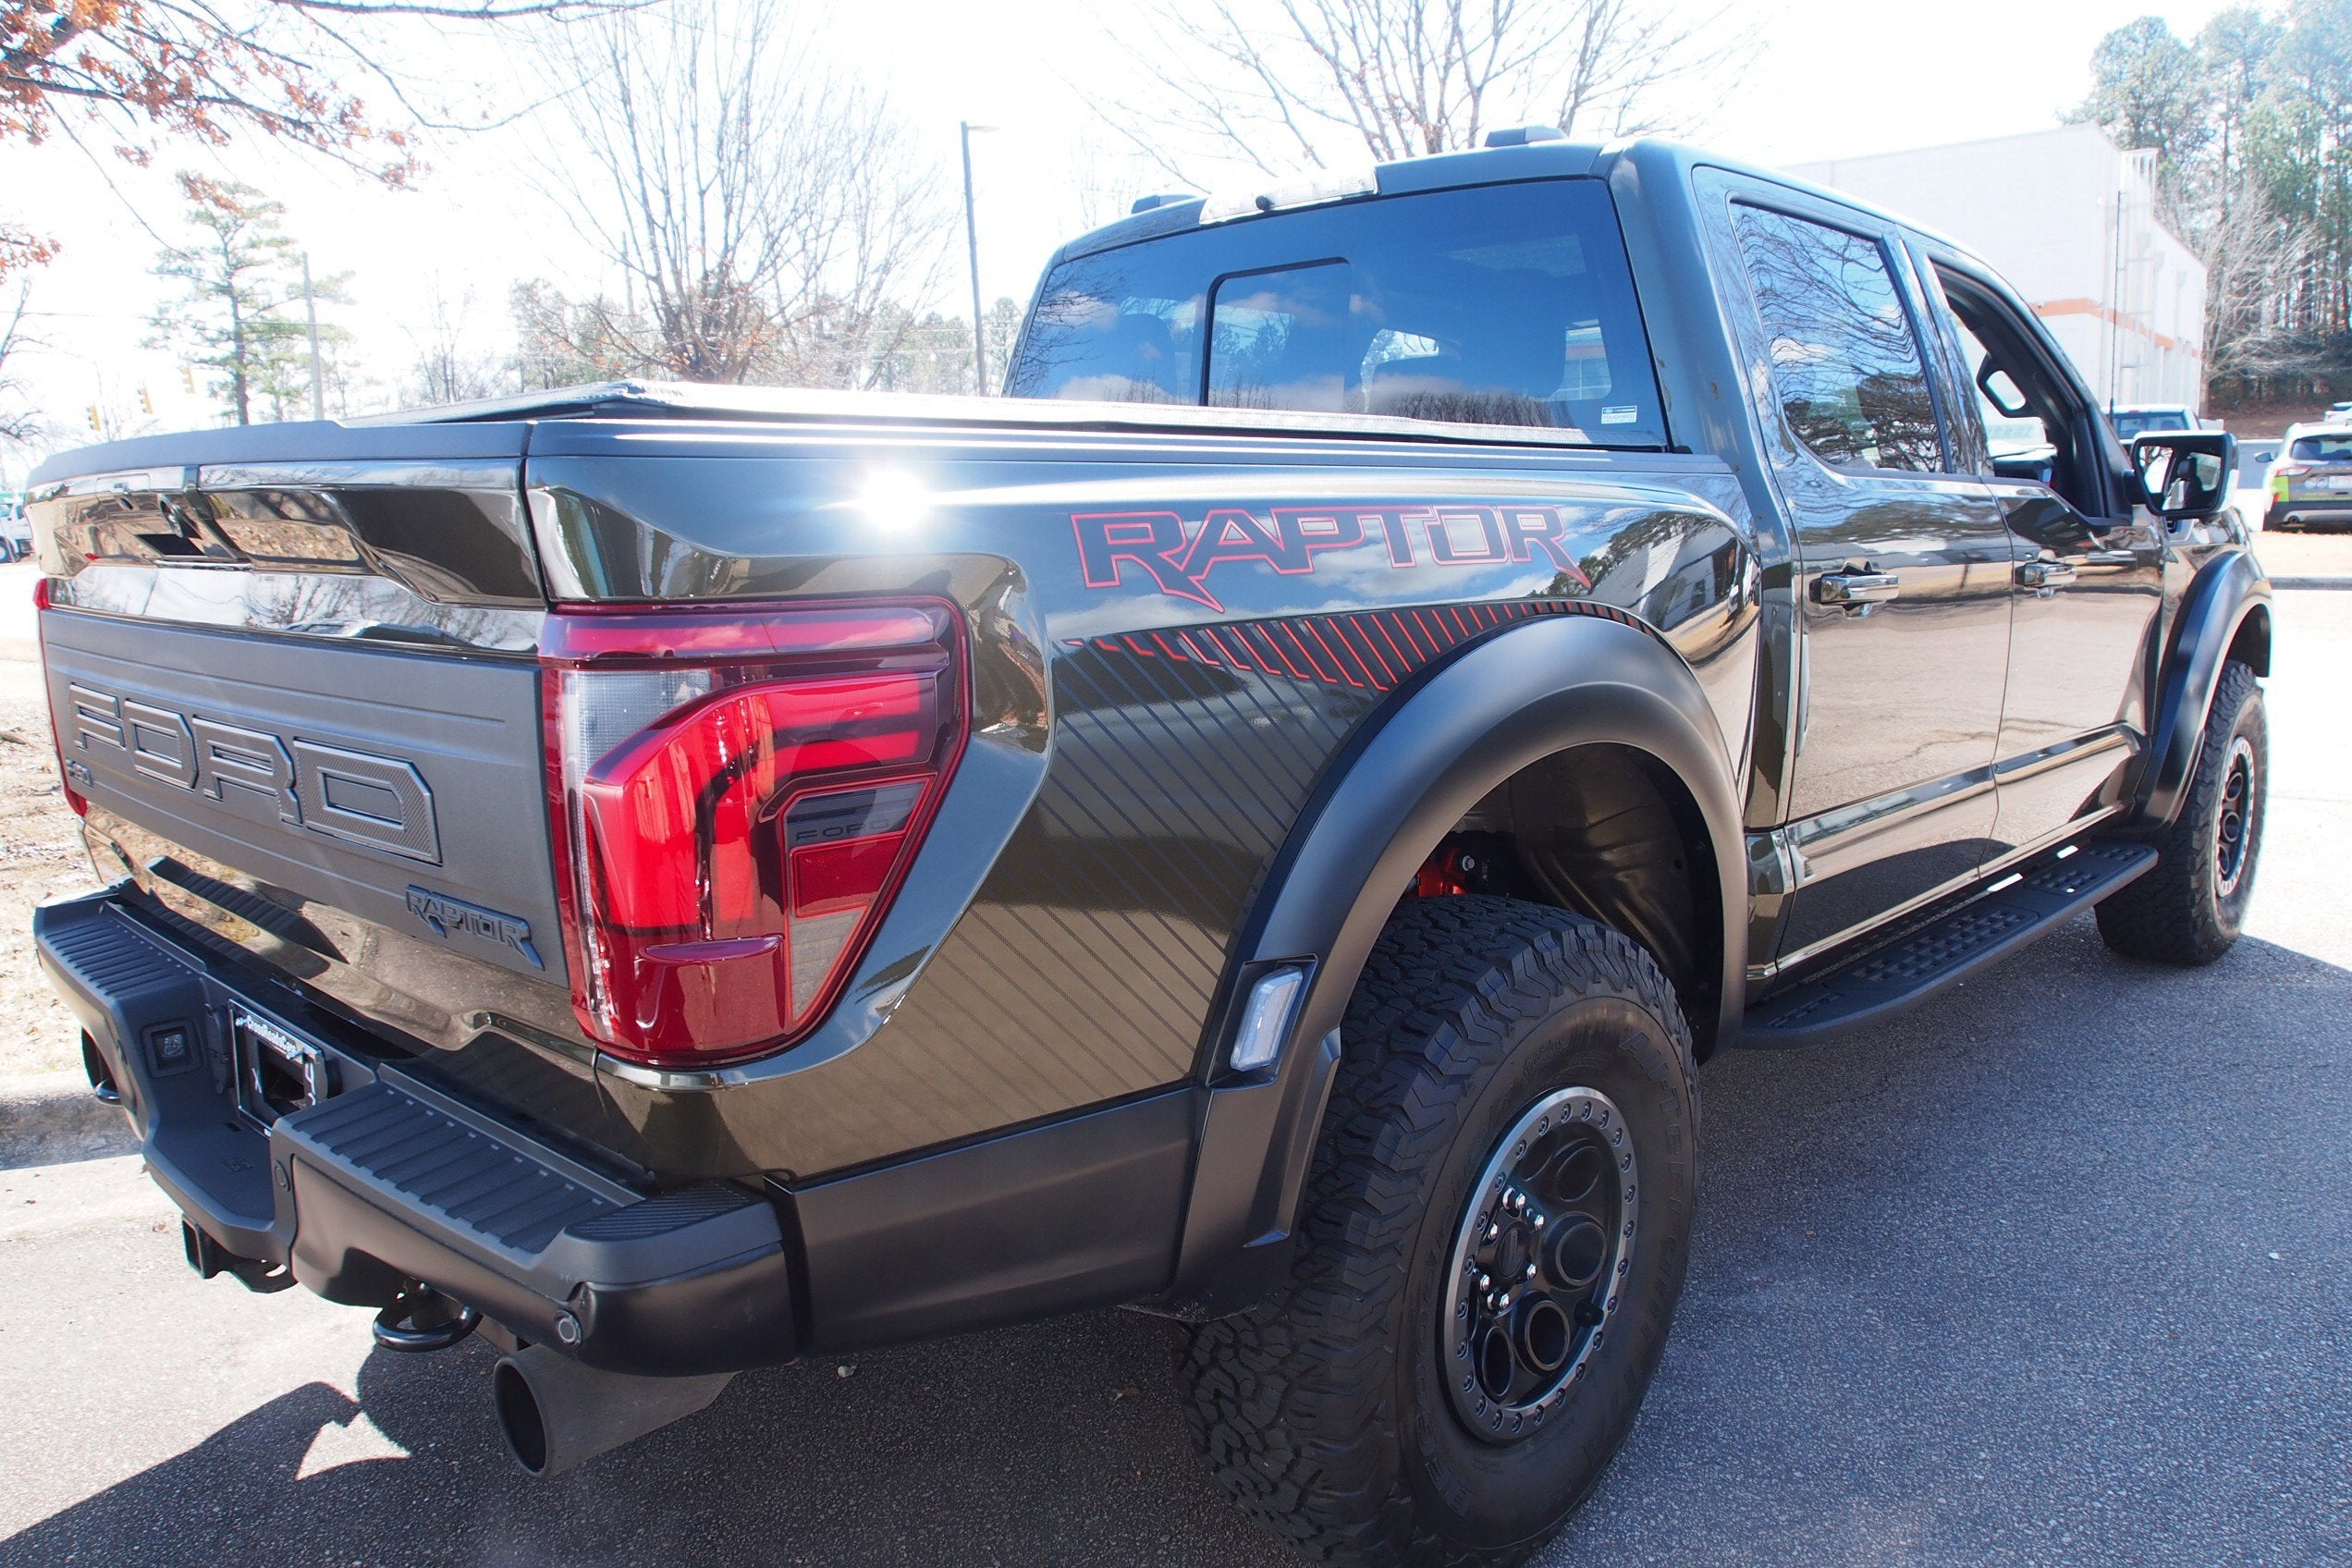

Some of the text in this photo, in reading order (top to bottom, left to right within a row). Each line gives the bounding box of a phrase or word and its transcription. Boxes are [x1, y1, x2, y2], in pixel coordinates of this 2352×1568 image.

[1070, 505, 1591, 614] RAPTOR
[68, 682, 443, 867] FORD
[405, 884, 545, 971] RAPTOR
